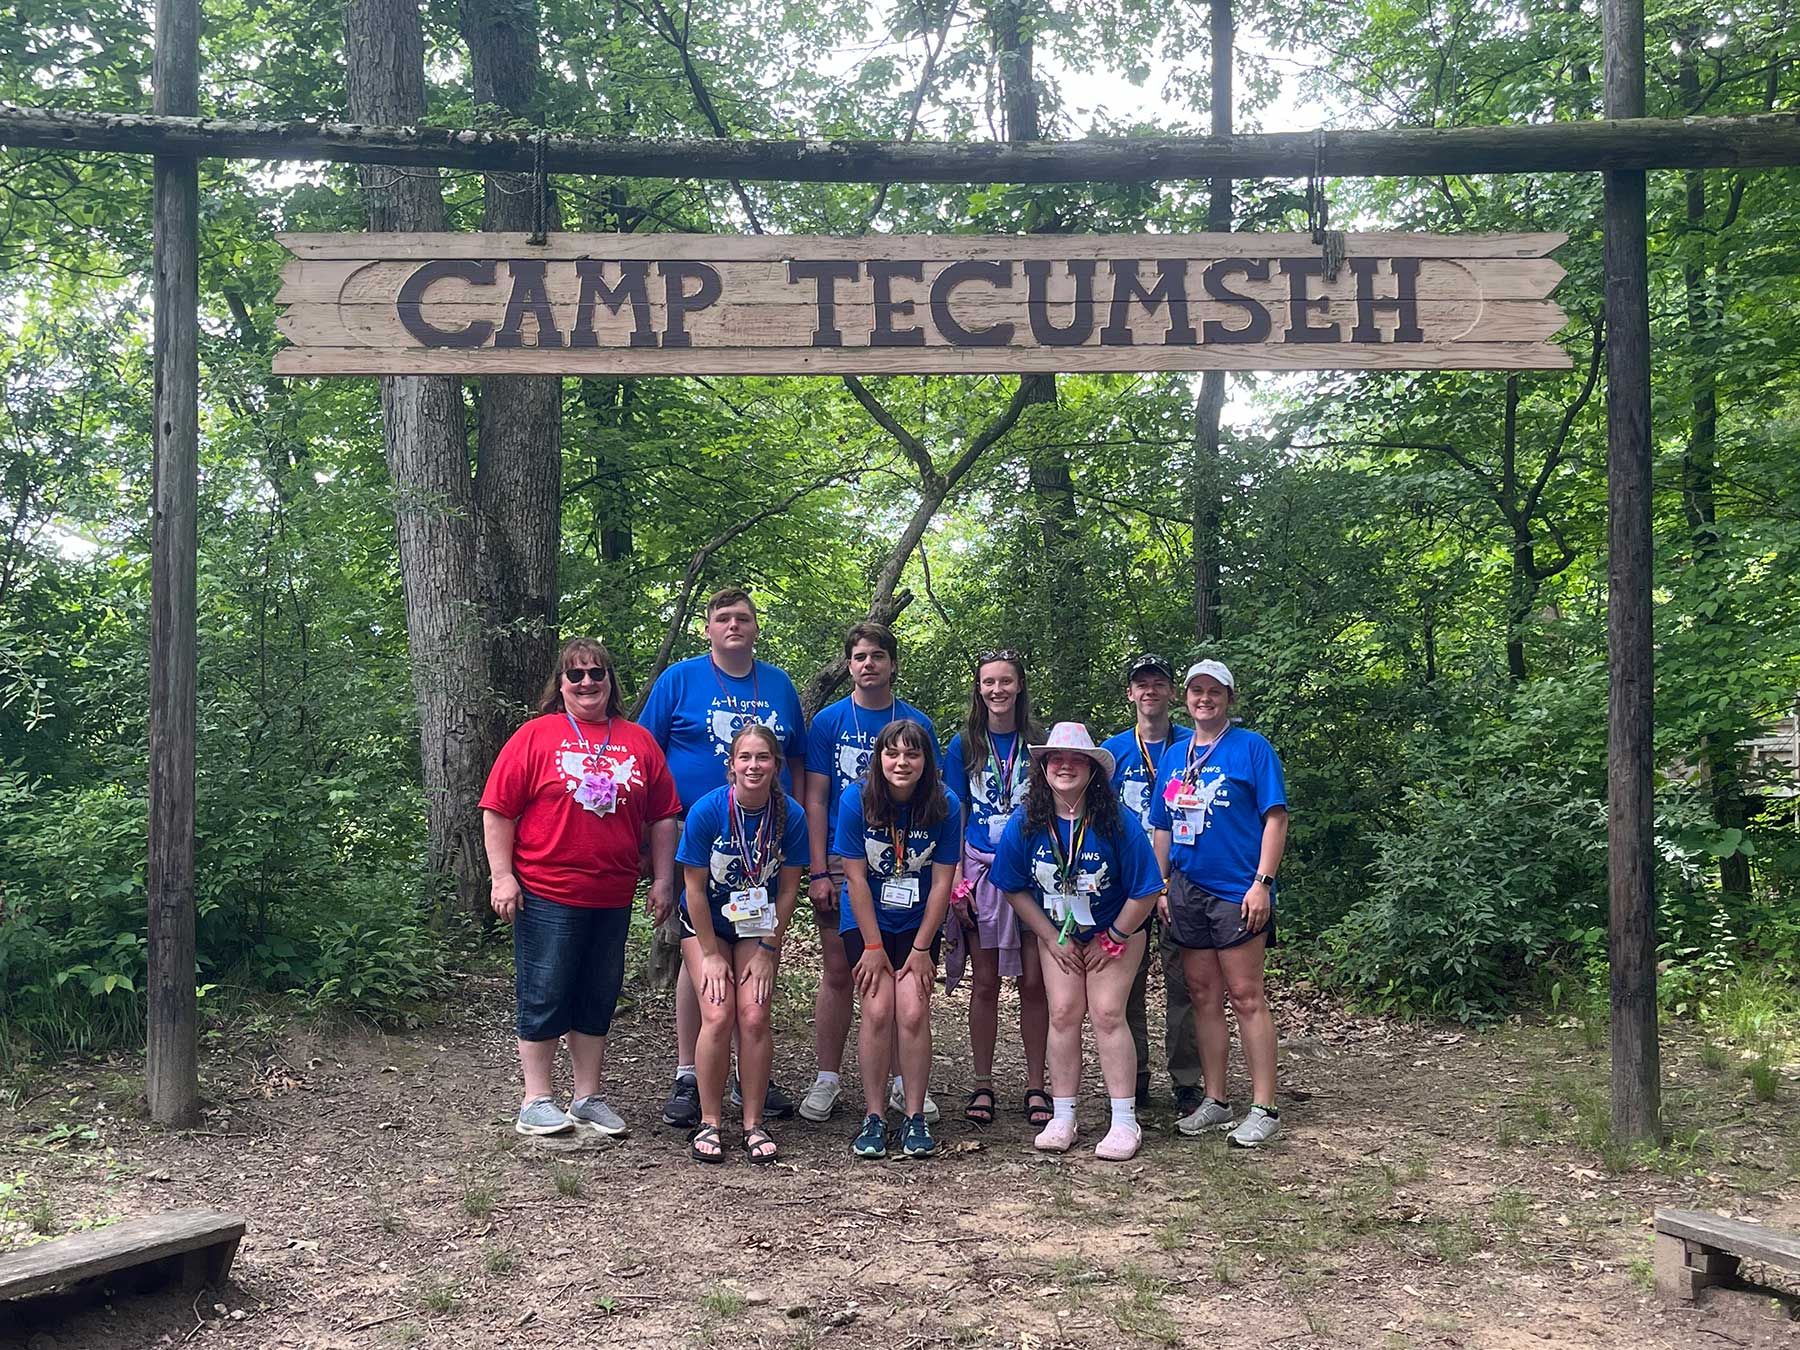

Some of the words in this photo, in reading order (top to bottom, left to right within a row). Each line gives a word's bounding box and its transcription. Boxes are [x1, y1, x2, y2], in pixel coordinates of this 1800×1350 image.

[396, 260, 723, 348] CAMP
[788, 258, 1424, 347] TECUMSEH
[711, 696, 737, 708] 4-H
[740, 699, 770, 712] grows
[841, 730, 867, 743] 4-H
[560, 739, 590, 749] 4-H
[593, 743, 628, 753] gows
